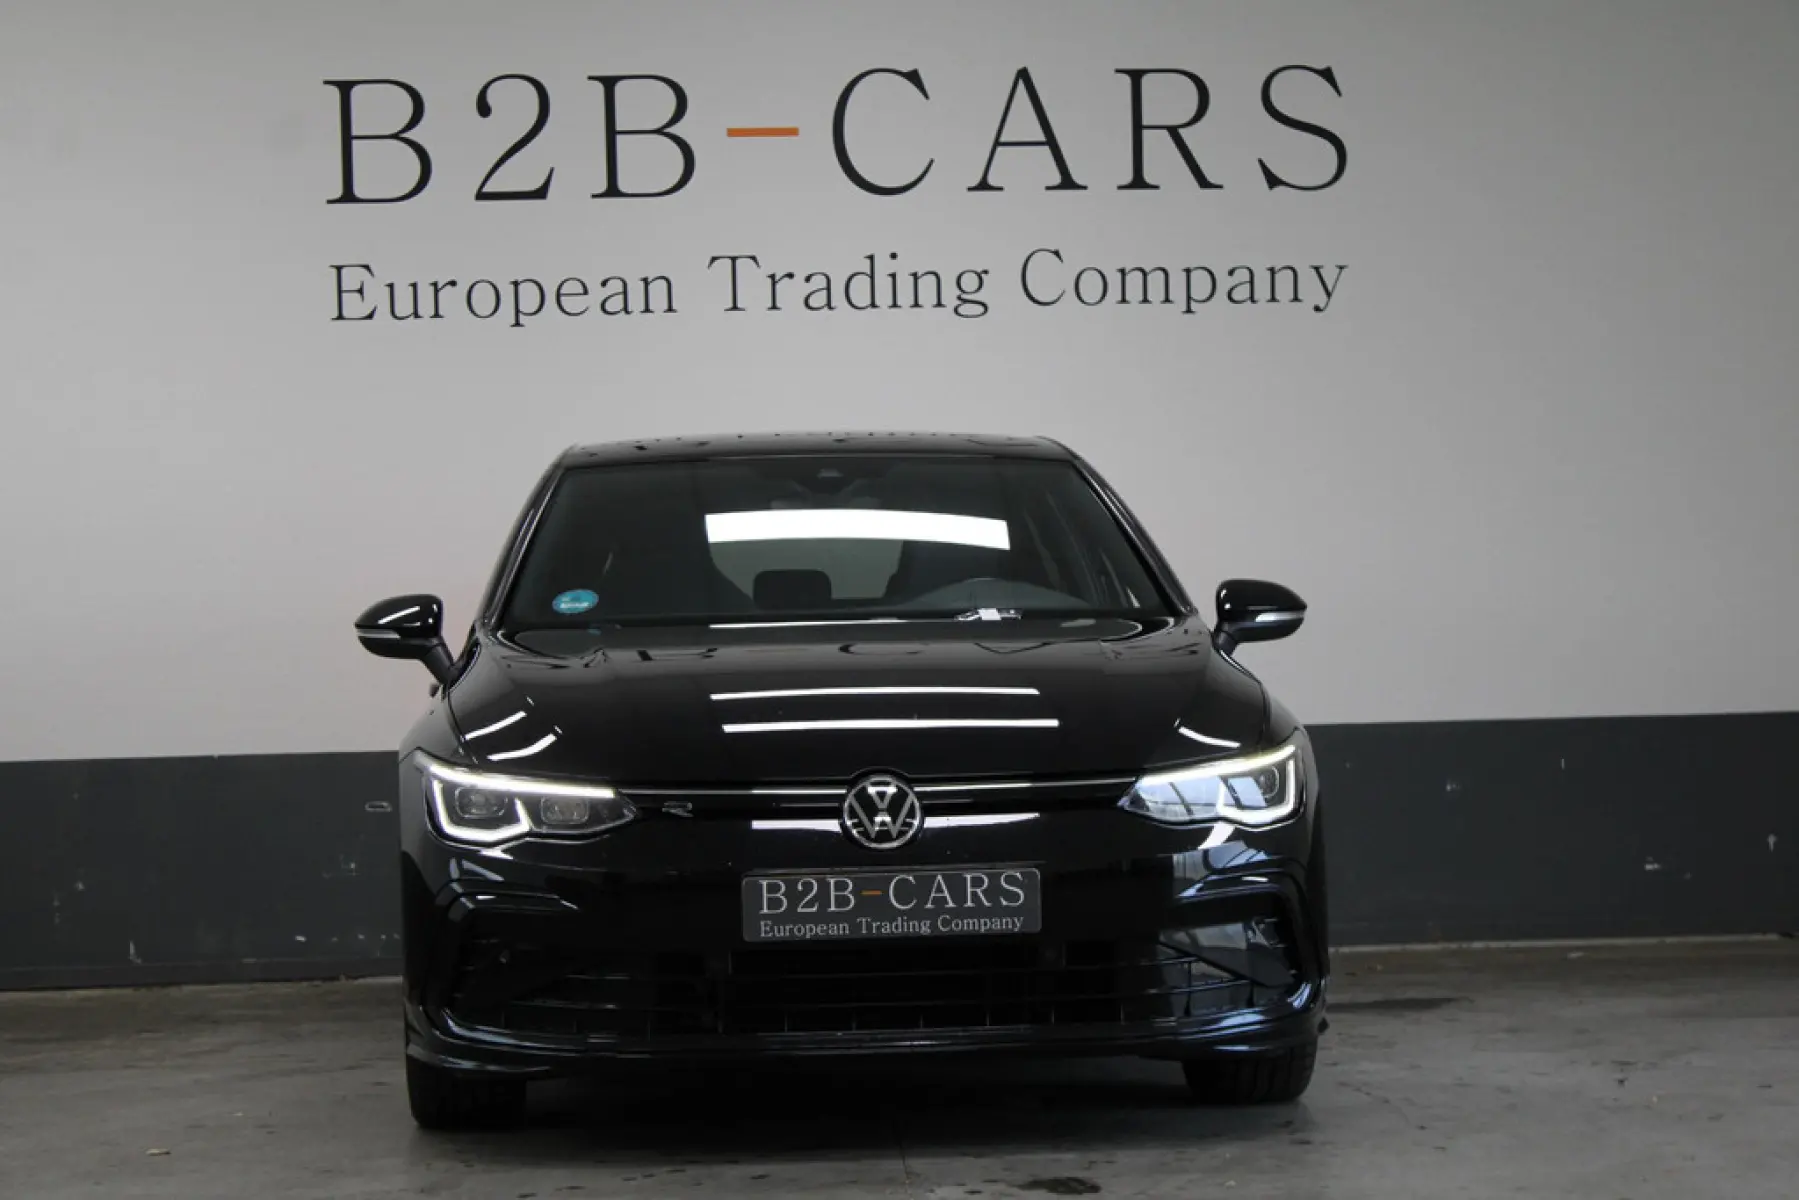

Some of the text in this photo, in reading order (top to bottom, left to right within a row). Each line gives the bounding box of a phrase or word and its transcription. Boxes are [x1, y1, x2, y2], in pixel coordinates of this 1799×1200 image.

[322, 64, 1350, 206] B2B-CARS
[329, 248, 1350, 329] European Trading Company
[843, 775, 920, 849] VW
[758, 872, 1025, 914] B2B-CARS
[759, 914, 1024, 939] European Trading Company
